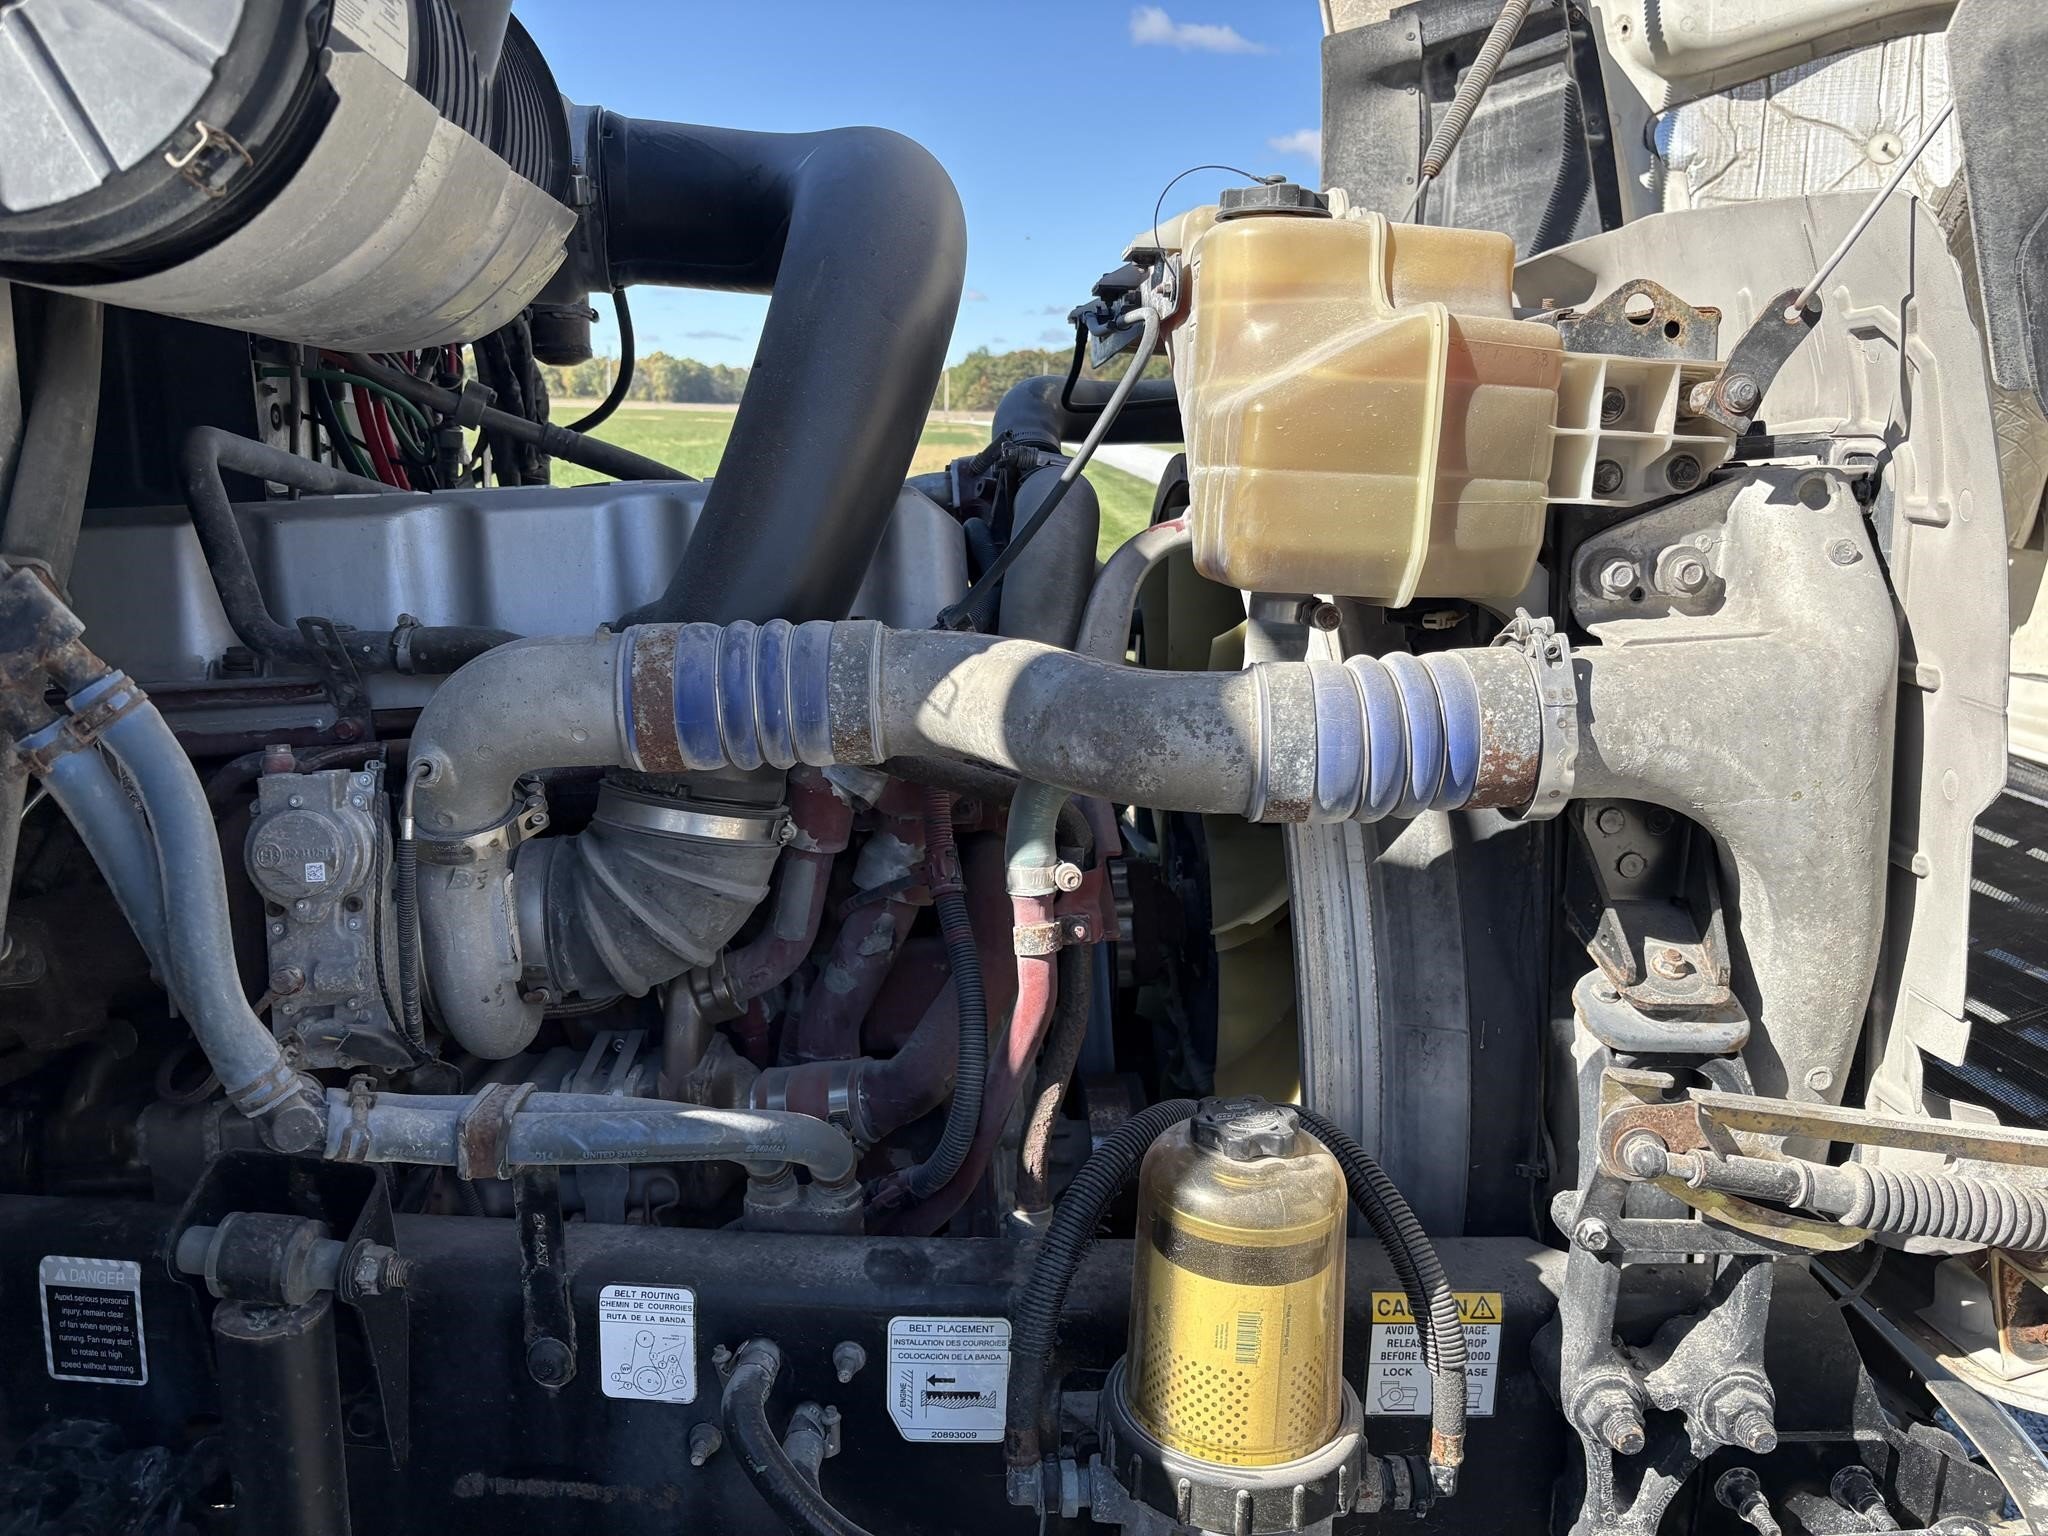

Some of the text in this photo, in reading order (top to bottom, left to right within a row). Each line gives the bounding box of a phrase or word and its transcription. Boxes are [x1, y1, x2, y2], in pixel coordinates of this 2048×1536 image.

[583, 1151, 615, 1159] UNITED
[70, 1268, 125, 1285] DANGER
[54, 1292, 129, 1306] Avoid serious personal
[614, 1289, 680, 1301] BELT ROUTING
[600, 1300, 630, 1309] CHEMIN
[647, 1303, 693, 1312] COURROIES
[61, 1307, 124, 1318] injury, remain clear
[606, 1313, 627, 1321] RUTA
[659, 1316, 687, 1324] BANDA
[60, 1319, 130, 1334] of fan when engine is
[909, 1324, 995, 1333] BELT PLACEMENT
[1385, 1326, 1414, 1335] AVOID
[87, 1335, 100, 1344] Fan
[101, 1336, 116, 1347] may
[117, 1337, 132, 1347] start
[893, 1338, 1007, 1347] INSTALLATION DES COURROIES
[1387, 1339, 1487, 1348] RELEAS ROP
[71, 1347, 123, 1360] to rotate at high
[964, 1353, 974, 1361] LA
[975, 1353, 1002, 1361] BANDA
[1380, 1351, 1418, 1361] BEFORE
[60, 1360, 81, 1370] speed
[82, 1361, 107, 1371] without
[1382, 1367, 1413, 1377] LOCK
[899, 1382, 907, 1408] ENGINE
[931, 1431, 977, 1439] 20893009
